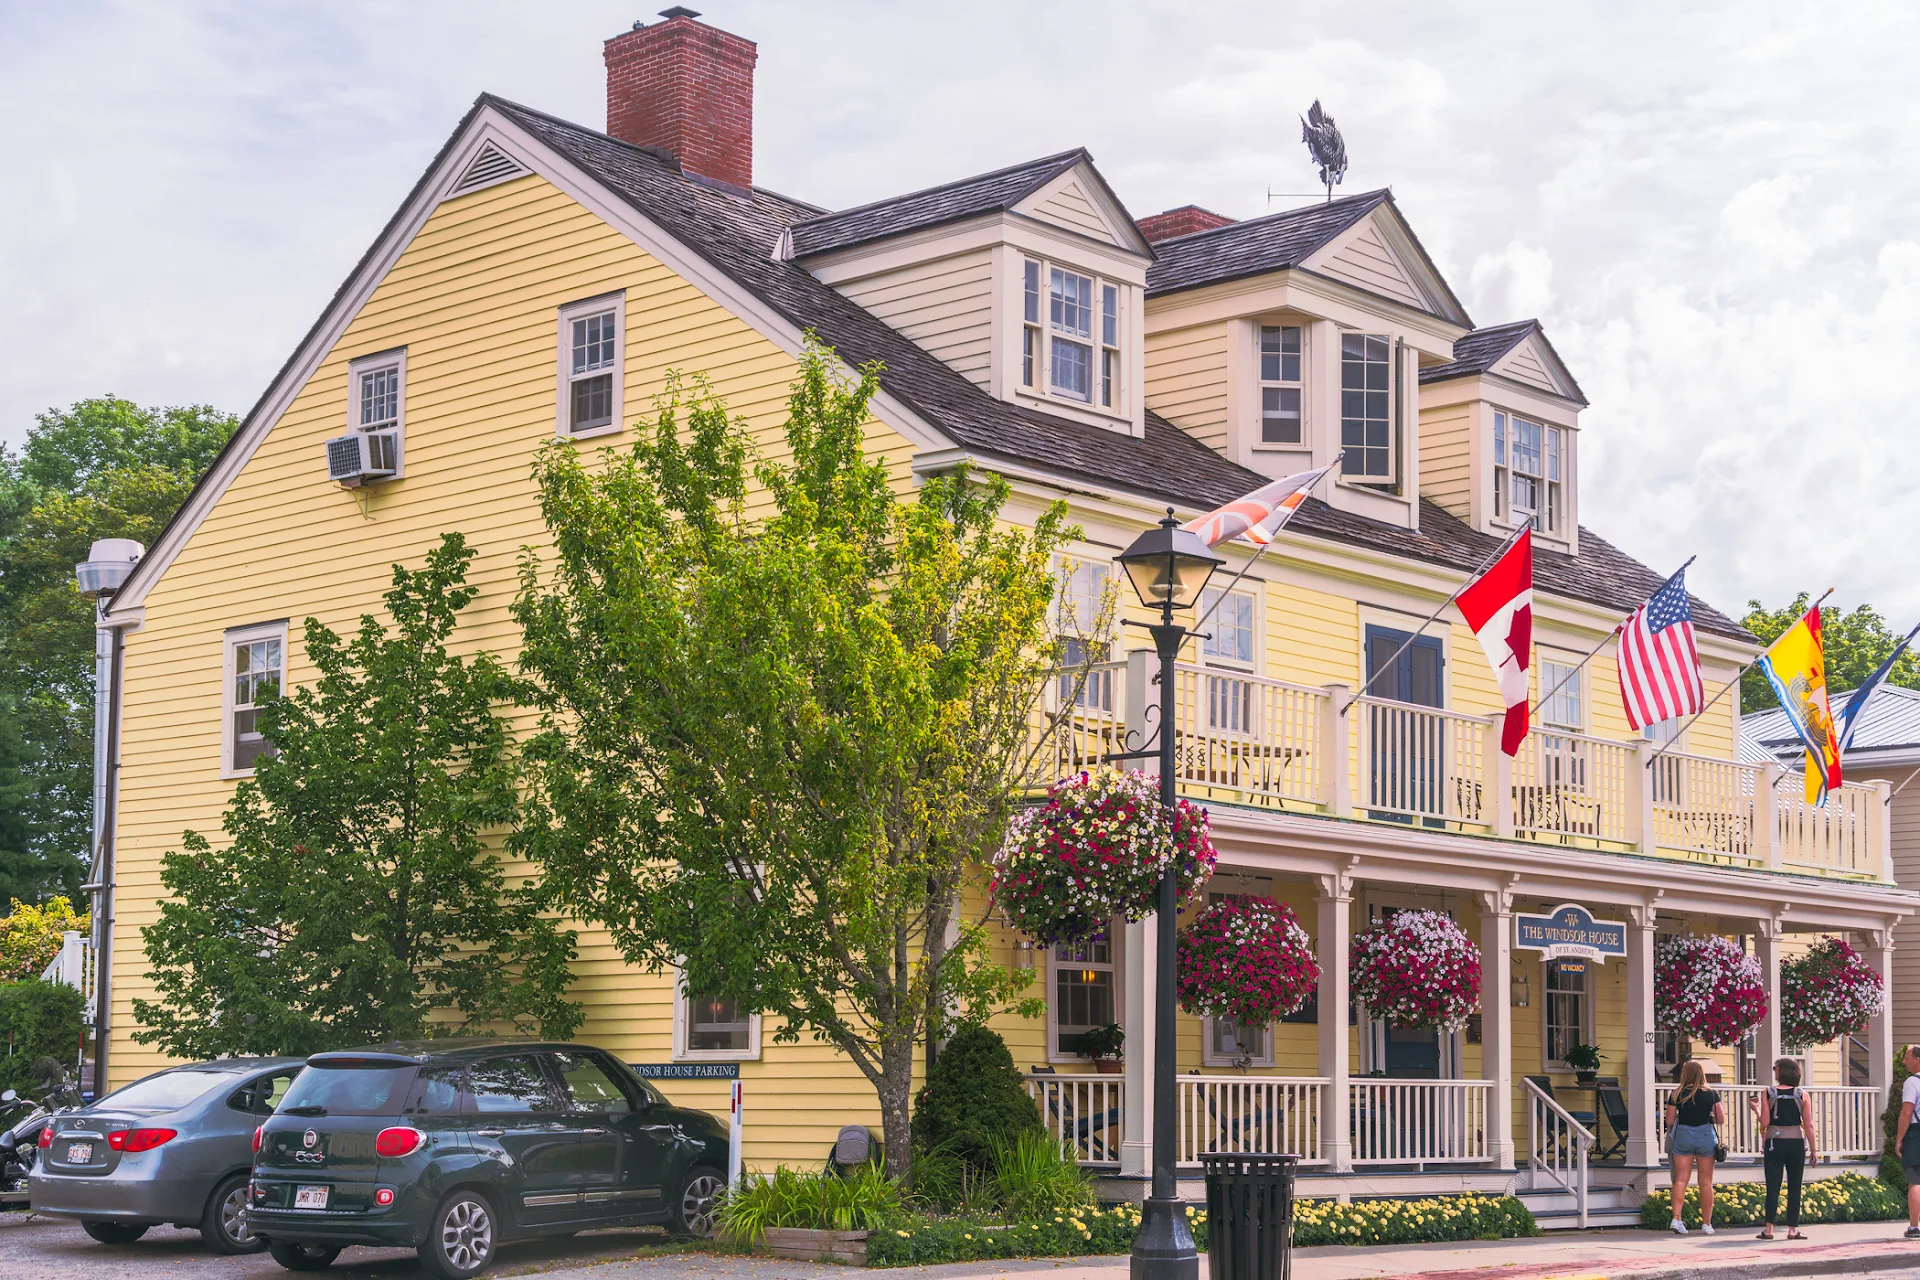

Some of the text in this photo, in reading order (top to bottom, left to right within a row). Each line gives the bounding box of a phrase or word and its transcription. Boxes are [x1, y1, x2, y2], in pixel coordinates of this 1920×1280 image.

[1567, 914, 1577, 927] W
[1523, 925, 1619, 946] THE WINDSOR HOUSE
[1555, 946, 1562, 954] OF
[1571, 947, 1594, 956] ANDREWS
[1567, 964, 1585, 972] VACANCY
[664, 1066, 693, 1076] HOUSE
[695, 1066, 735, 1076] PARKING
[313, 1192, 326, 1203] 070
